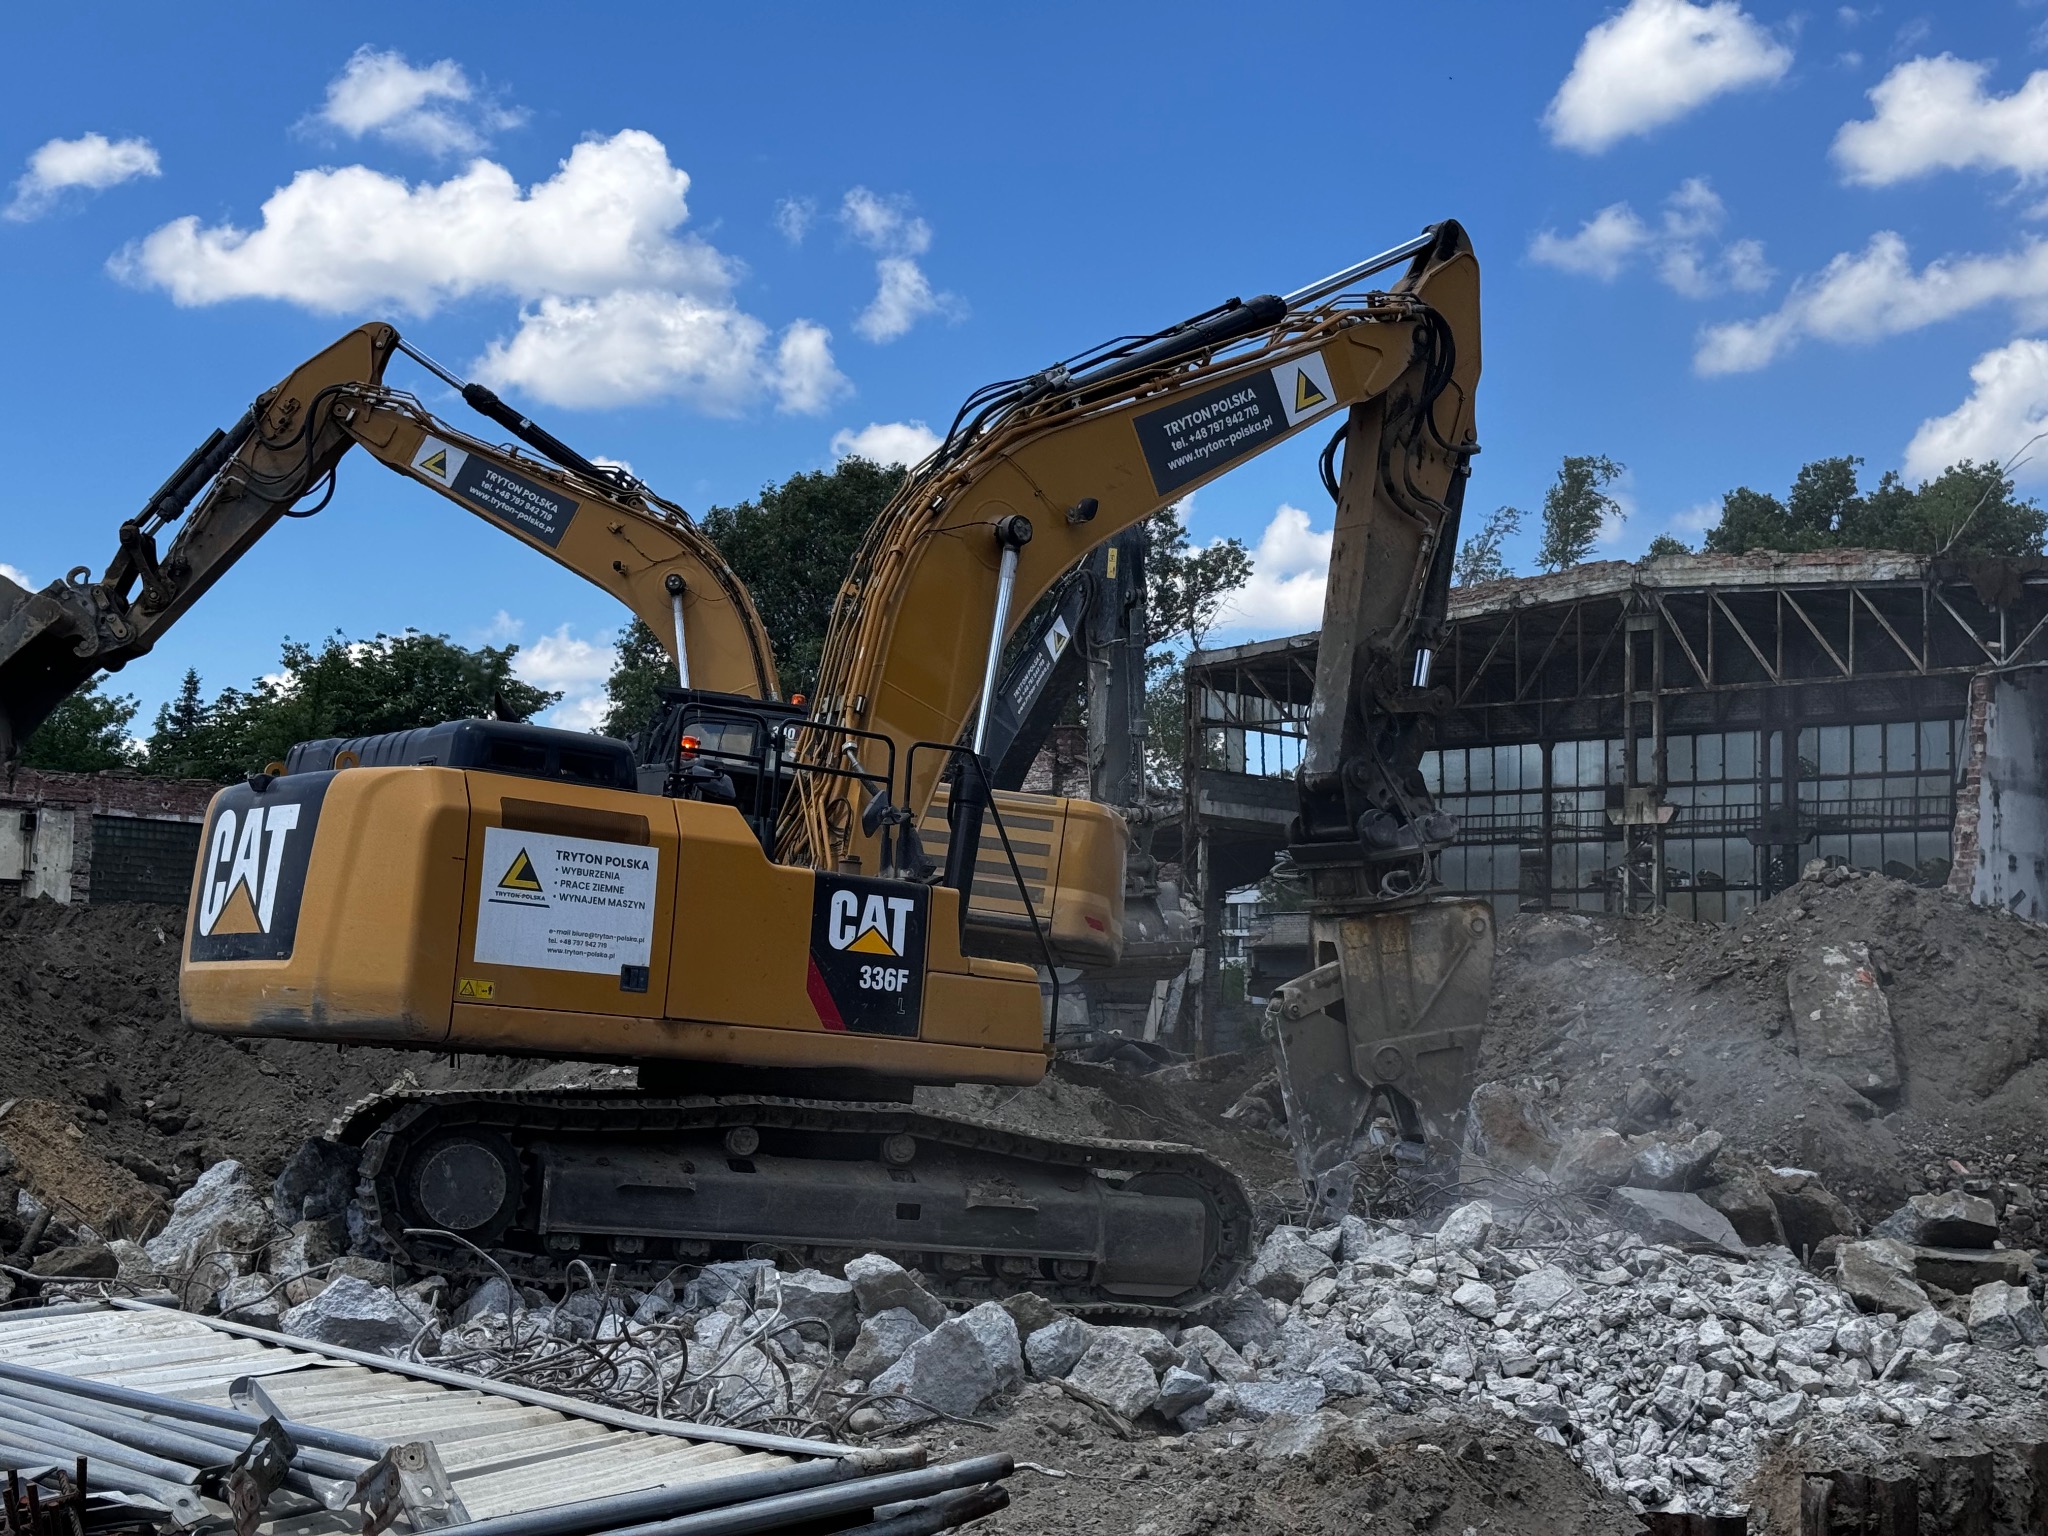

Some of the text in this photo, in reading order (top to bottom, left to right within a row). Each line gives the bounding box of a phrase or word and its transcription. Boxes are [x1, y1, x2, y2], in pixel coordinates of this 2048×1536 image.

[1163, 388, 1257, 437] TRYTON POLSKA
[1171, 404, 1260, 451] tel. +48 797 942 719
[1167, 415, 1273, 471] www.tryton-polska.pl
[469, 486, 555, 534] www.tryton-polska.pl
[481, 480, 553, 521] tel. +48 797 942 719
[485, 469, 558, 513] TRYTON POLSKA
[1013, 652, 1043, 698] TRYTON POLSKA
[199, 803, 301, 937] CAT
[556, 850, 650, 870] TRYTON POLSKA
[561, 866, 621, 880] WYBURZENIA
[559, 893, 646, 910] WYNAJEM MASZYN
[560, 879, 625, 894] PRACE ZIEMNE
[571, 930, 645, 944] biuro@tryton-polska.pl
[573, 939, 583, 947] 797
[828, 890, 915, 957] CAT
[547, 948, 615, 960] www.tryton-polska.pl
[859, 965, 910, 992] 336F
